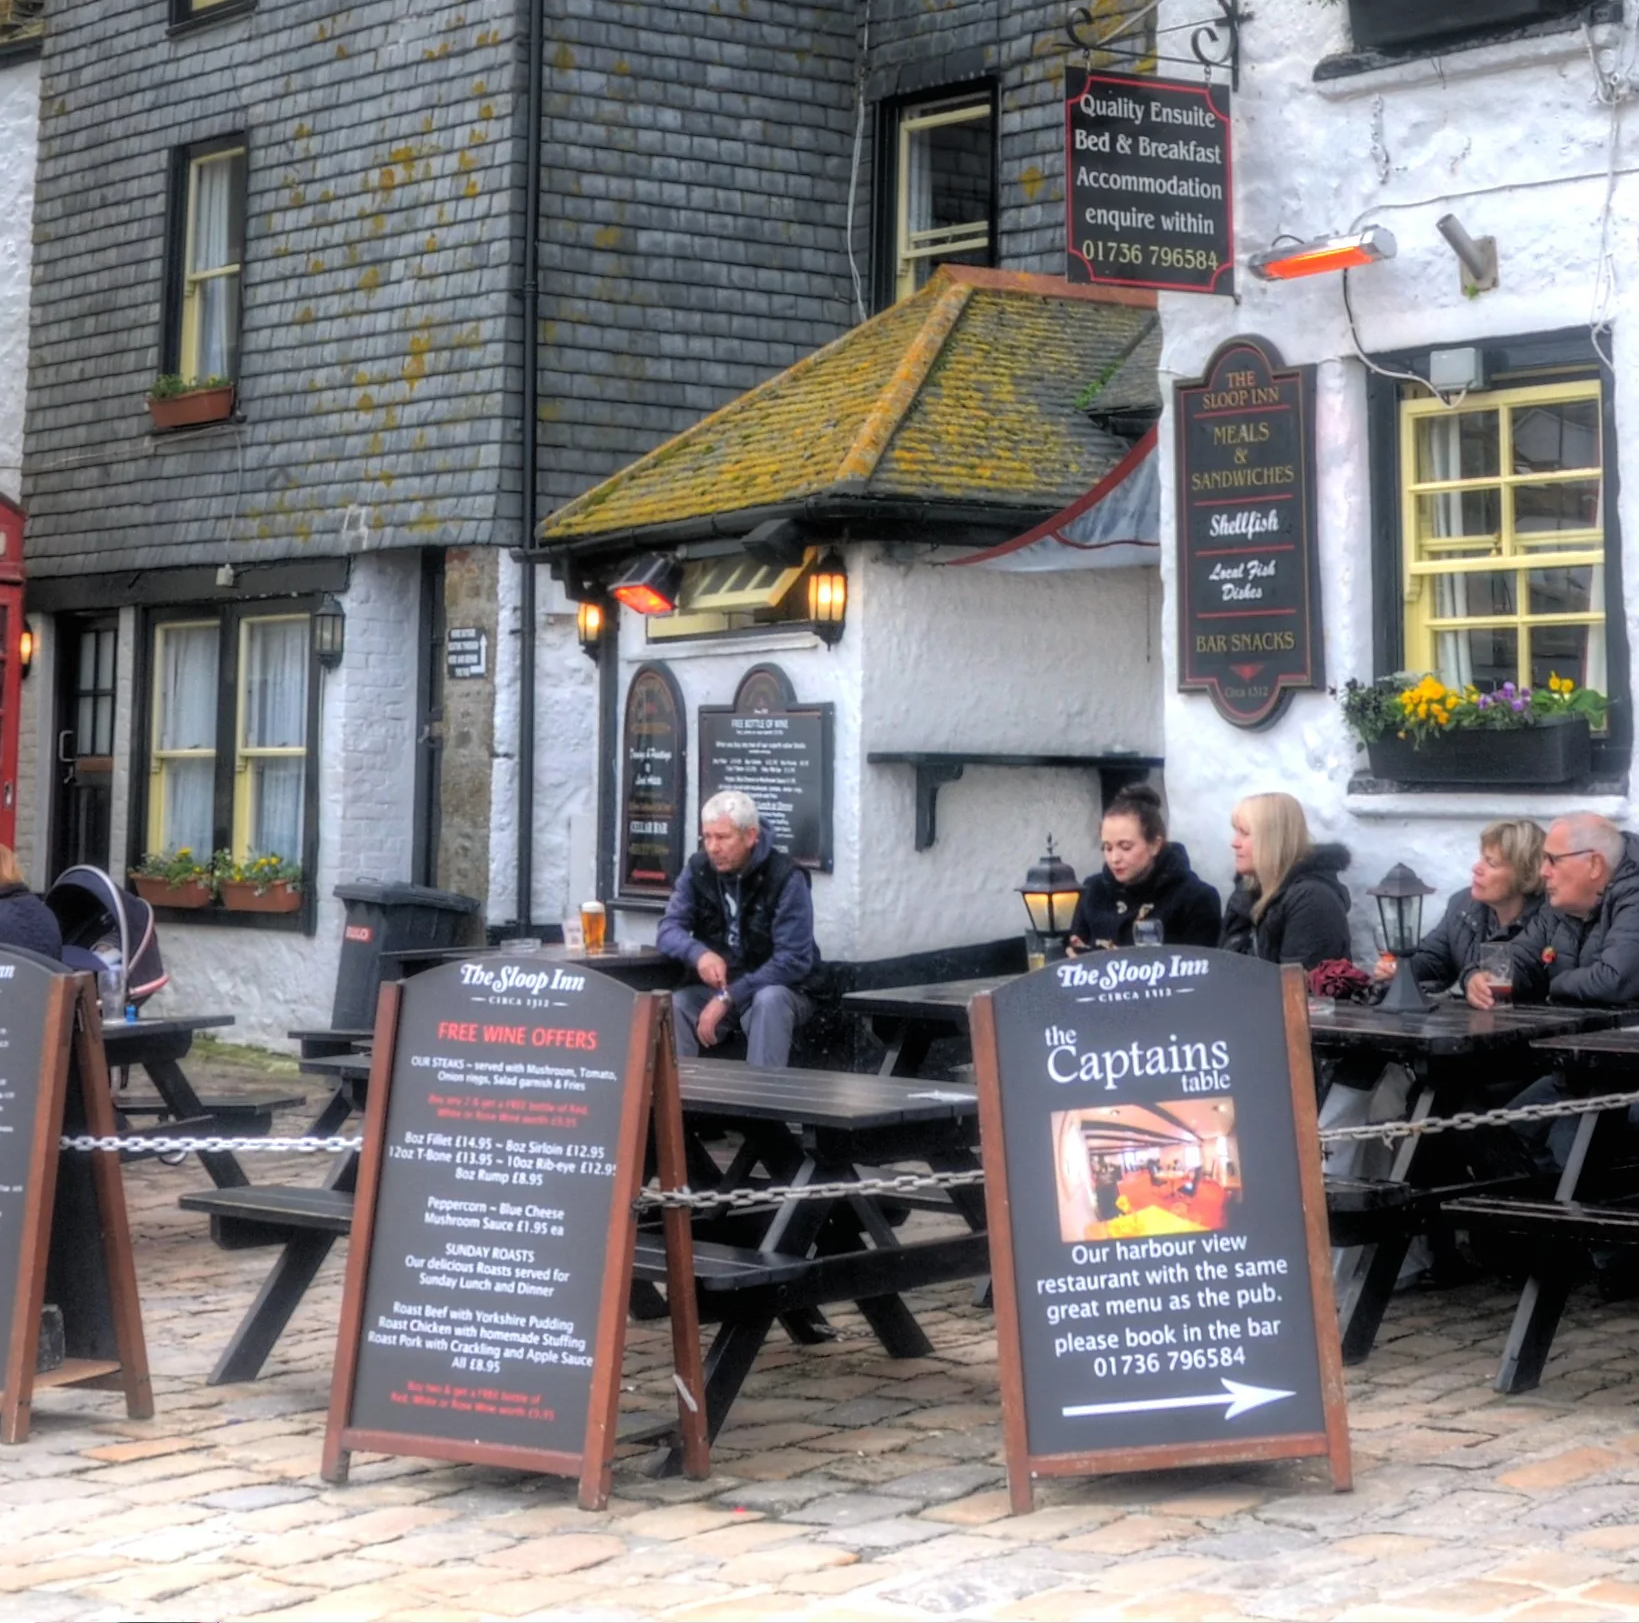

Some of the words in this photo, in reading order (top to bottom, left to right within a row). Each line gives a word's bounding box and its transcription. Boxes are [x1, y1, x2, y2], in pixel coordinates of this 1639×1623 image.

[1080, 94, 1145, 124] Quality
[1150, 102, 1215, 128] Ensuite
[1075, 130, 1110, 152] Bed
[1116, 134, 1132, 154] &
[1139, 137, 1221, 164] Breakfast
[1076, 166, 1222, 200] Accommodation
[1085, 207, 1155, 231] enquire
[1161, 211, 1214, 234] within
[1083, 240, 1142, 264] 01736
[1149, 246, 1218, 270] 796584
[1226, 370, 1256, 387] THE
[1203, 390, 1248, 409] SLOOP
[1252, 387, 1279, 404] INN
[1214, 422, 1269, 445] MEALS
[1234, 447, 1247, 463] &
[1192, 465, 1294, 490] SANDWICHES
[1210, 509, 1279, 540] Shellfish
[1209, 562, 1244, 581] Local
[1246, 560, 1276, 580] Fish
[1222, 583, 1262, 601] Dishes
[1196, 634, 1227, 653] BAR
[1232, 632, 1294, 652] SNACKS
[460, 964, 493, 986] The
[492, 966, 549, 995] Sloop
[550, 969, 586, 992] Inn
[1057, 963, 1098, 988] The
[1099, 958, 1165, 991] Sloop
[1169, 955, 1209, 977] Inn
[489, 996, 522, 1006] CIRCA
[528, 999, 550, 1008] 1312
[1098, 991, 1139, 1003] CIRCA
[438, 1021, 478, 1042] FREE
[483, 1026, 526, 1045] WINE
[531, 1028, 598, 1050] OFFERS
[1045, 1026, 1077, 1046] the
[1048, 1034, 1230, 1090] Captains
[1181, 1071, 1231, 1093] table
[405, 1131, 424, 1144] 8oz
[427, 1133, 453, 1146] Fillet
[455, 1136, 492, 1150] £14.95
[506, 1140, 526, 1153] 8oz
[529, 1141, 563, 1156] Sirloin
[566, 1145, 604, 1159] £12.95
[445, 1243, 490, 1258] SUNDAY
[492, 1249, 535, 1263] ROASTS
[1072, 1244, 1109, 1265] Our
[1116, 1239, 1196, 1261] harbour
[1201, 1234, 1248, 1253] view
[405, 1255, 425, 1269] Our
[427, 1257, 474, 1274] delicious
[477, 1262, 512, 1277] Roasts
[515, 1266, 551, 1280] served
[553, 1268, 570, 1282] for
[1037, 1270, 1139, 1294] restaurant
[1145, 1265, 1189, 1285] with
[1196, 1261, 1228, 1281] the
[1235, 1257, 1288, 1278] same
[419, 1273, 459, 1290] Sunday
[460, 1277, 492, 1291] Lunch
[494, 1281, 515, 1293] and
[517, 1282, 555, 1297] Dinner
[1047, 1300, 1099, 1325] great
[1106, 1296, 1161, 1315] menu
[1169, 1293, 1190, 1310] as
[1197, 1288, 1229, 1307] the
[1236, 1284, 1282, 1308] pub.
[1055, 1332, 1119, 1357] please
[1126, 1325, 1176, 1347] book
[1183, 1324, 1202, 1342] in
[1208, 1320, 1241, 1340] the
[1248, 1318, 1281, 1337] bar
[451, 1357, 467, 1370] All
[469, 1359, 501, 1374] £8.95
[1094, 1353, 1160, 1377] 01736
[1168, 1347, 1245, 1371] 796584
